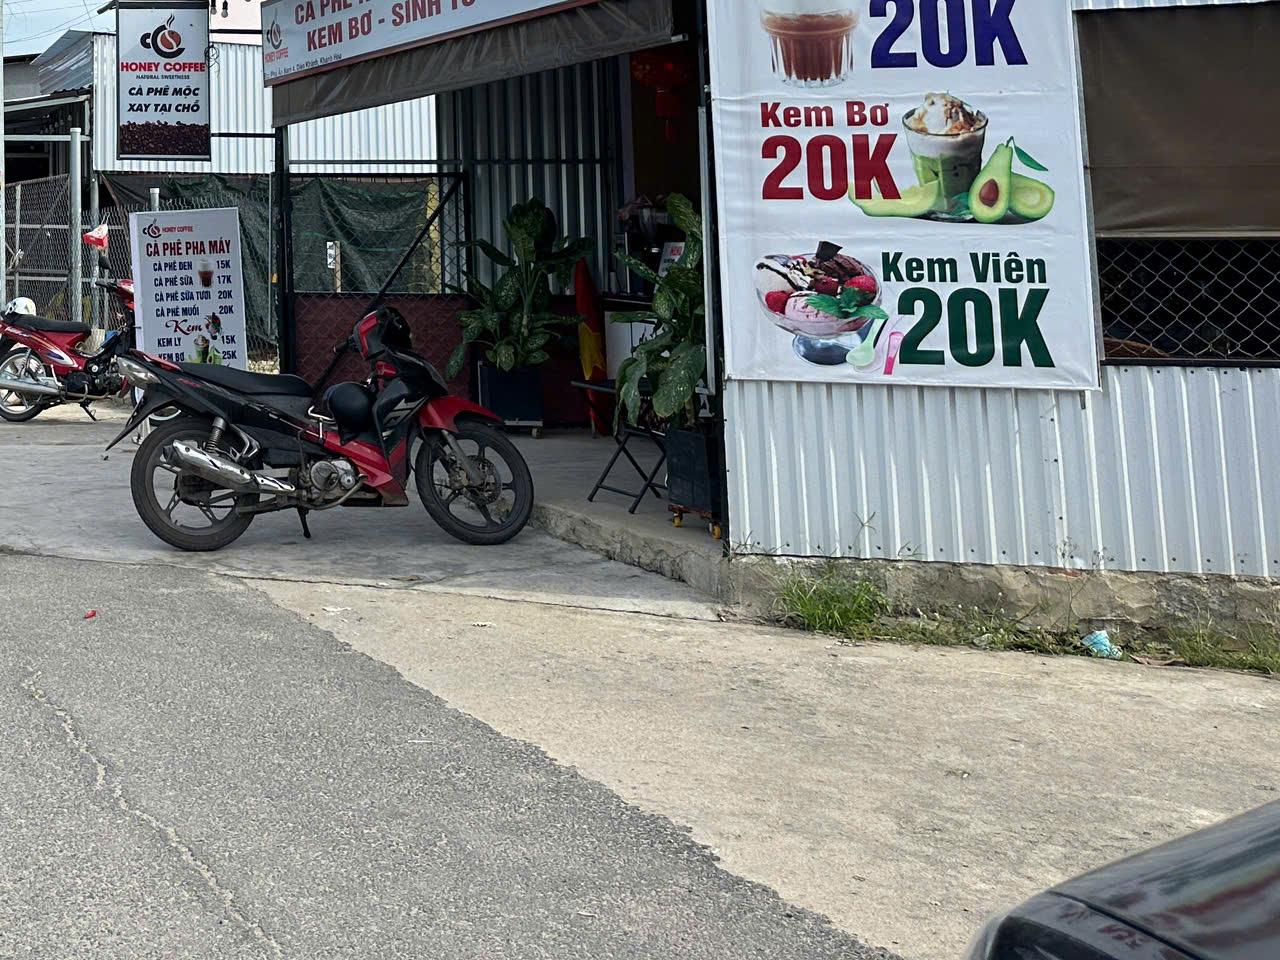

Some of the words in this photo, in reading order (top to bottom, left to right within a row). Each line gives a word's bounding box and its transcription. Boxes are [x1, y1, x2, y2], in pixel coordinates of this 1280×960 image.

[307, 22, 343, 52] KEM
[348, 9, 372, 40] BƠ
[121, 62, 160, 72] HONEY
[163, 62, 206, 72] COFFEE
[128, 85, 143, 96] CÀ
[146, 85, 170, 96] PHÊ
[172, 85, 200, 99] MỘC
[127, 103, 151, 112] XAY
[154, 103, 172, 115] TẠI
[175, 100, 200, 112] CHỖ
[760, 101, 835, 128] Kem
[846, 100, 890, 127] Bơ
[761, 133, 902, 201] 20K
[146, 240, 160, 257] CÀ
[162, 239, 182, 256] PHÊ
[185, 241, 206, 255] PHA
[208, 237, 231, 254] MÁY
[153, 261, 162, 272] CÀ
[164, 260, 177, 271] PHÊ
[216, 260, 231, 269] 15K
[881, 251, 958, 283] Kem
[969, 251, 1047, 284] Viên
[154, 276, 163, 287] CÀ
[165, 275, 178, 286] PHÊ
[217, 275, 232, 284] 17K
[155, 291, 164, 302] CÀ
[166, 290, 179, 301] PHÊ
[218, 290, 232, 299] 20K
[155, 306, 165, 317] CÀ
[167, 305, 180, 317] PHÊ
[182, 304, 199, 316] MUỐI
[219, 305, 234, 314] 20K
[165, 319, 203, 335] Kem
[897, 287, 1056, 368] 20K
[157, 337, 173, 347] KEM
[174, 337, 181, 346] LY
[221, 335, 236, 344] 15K
[222, 350, 237, 359] 25K
